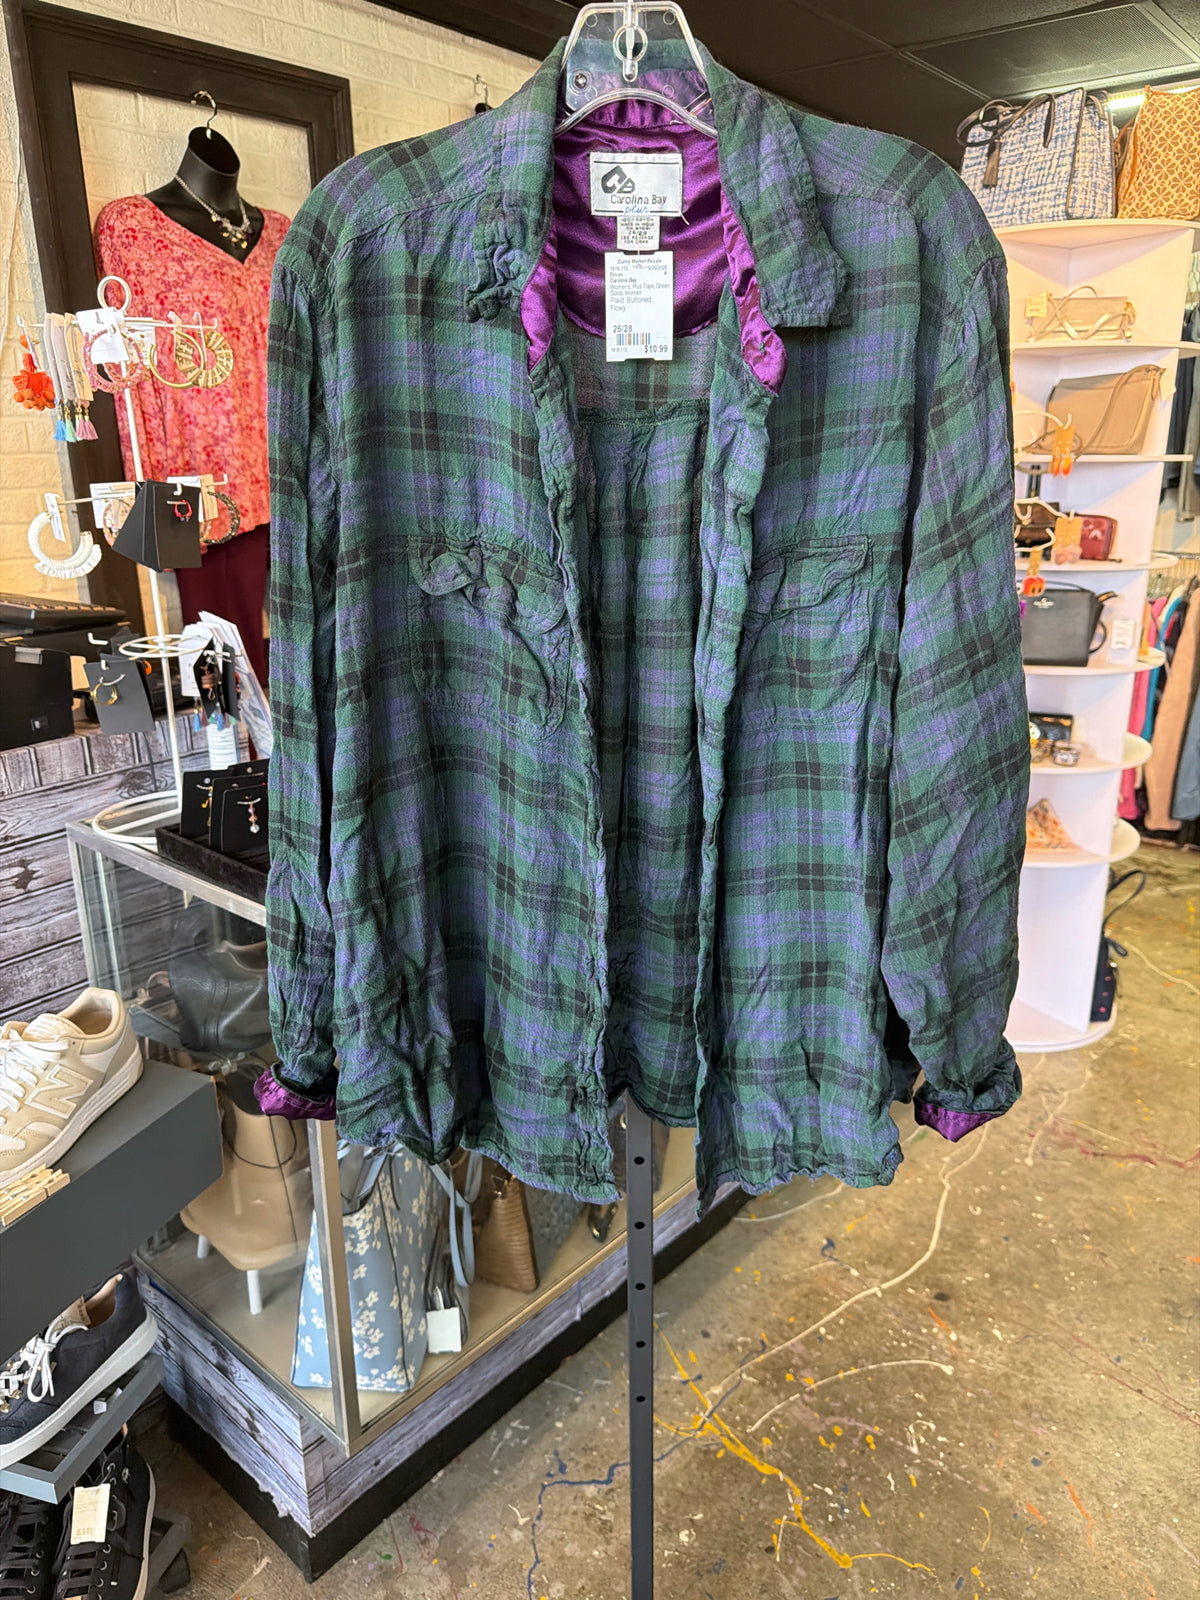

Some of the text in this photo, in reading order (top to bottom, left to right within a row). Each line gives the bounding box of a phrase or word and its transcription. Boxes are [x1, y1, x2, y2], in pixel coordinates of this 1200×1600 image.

[610, 194, 667, 206] Carolina Bay
[624, 204, 650, 214] plus
[610, 304, 626, 312] Flowy
[613, 324, 633, 333] 26/28
[644, 344, 668, 353] $10.99
